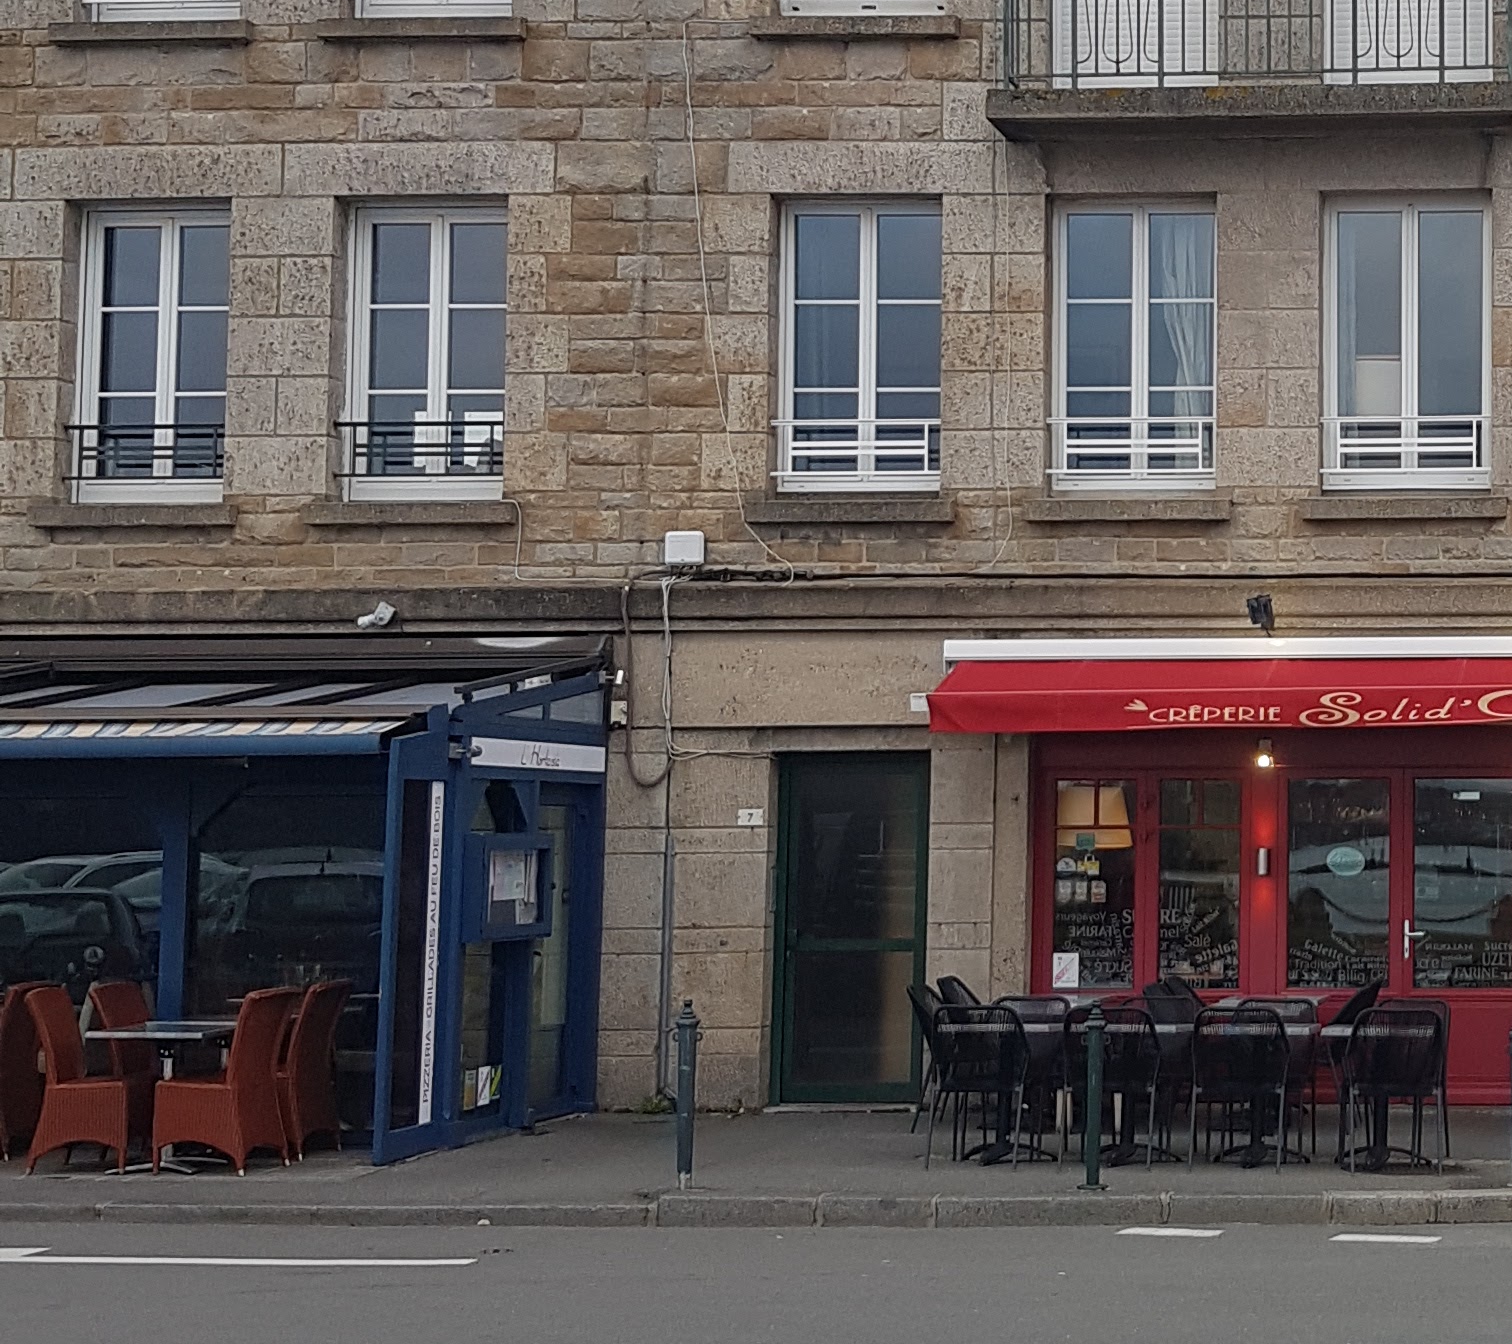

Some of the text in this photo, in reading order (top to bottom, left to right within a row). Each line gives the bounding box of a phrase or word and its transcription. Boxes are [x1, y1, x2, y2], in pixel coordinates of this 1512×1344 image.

[1148, 704, 1281, 723] CRÊPERIE
[747, 812, 754, 823] 7
[422, 795, 441, 1104] PIZZERIA GRILLADES AU FEU DE BOIS
